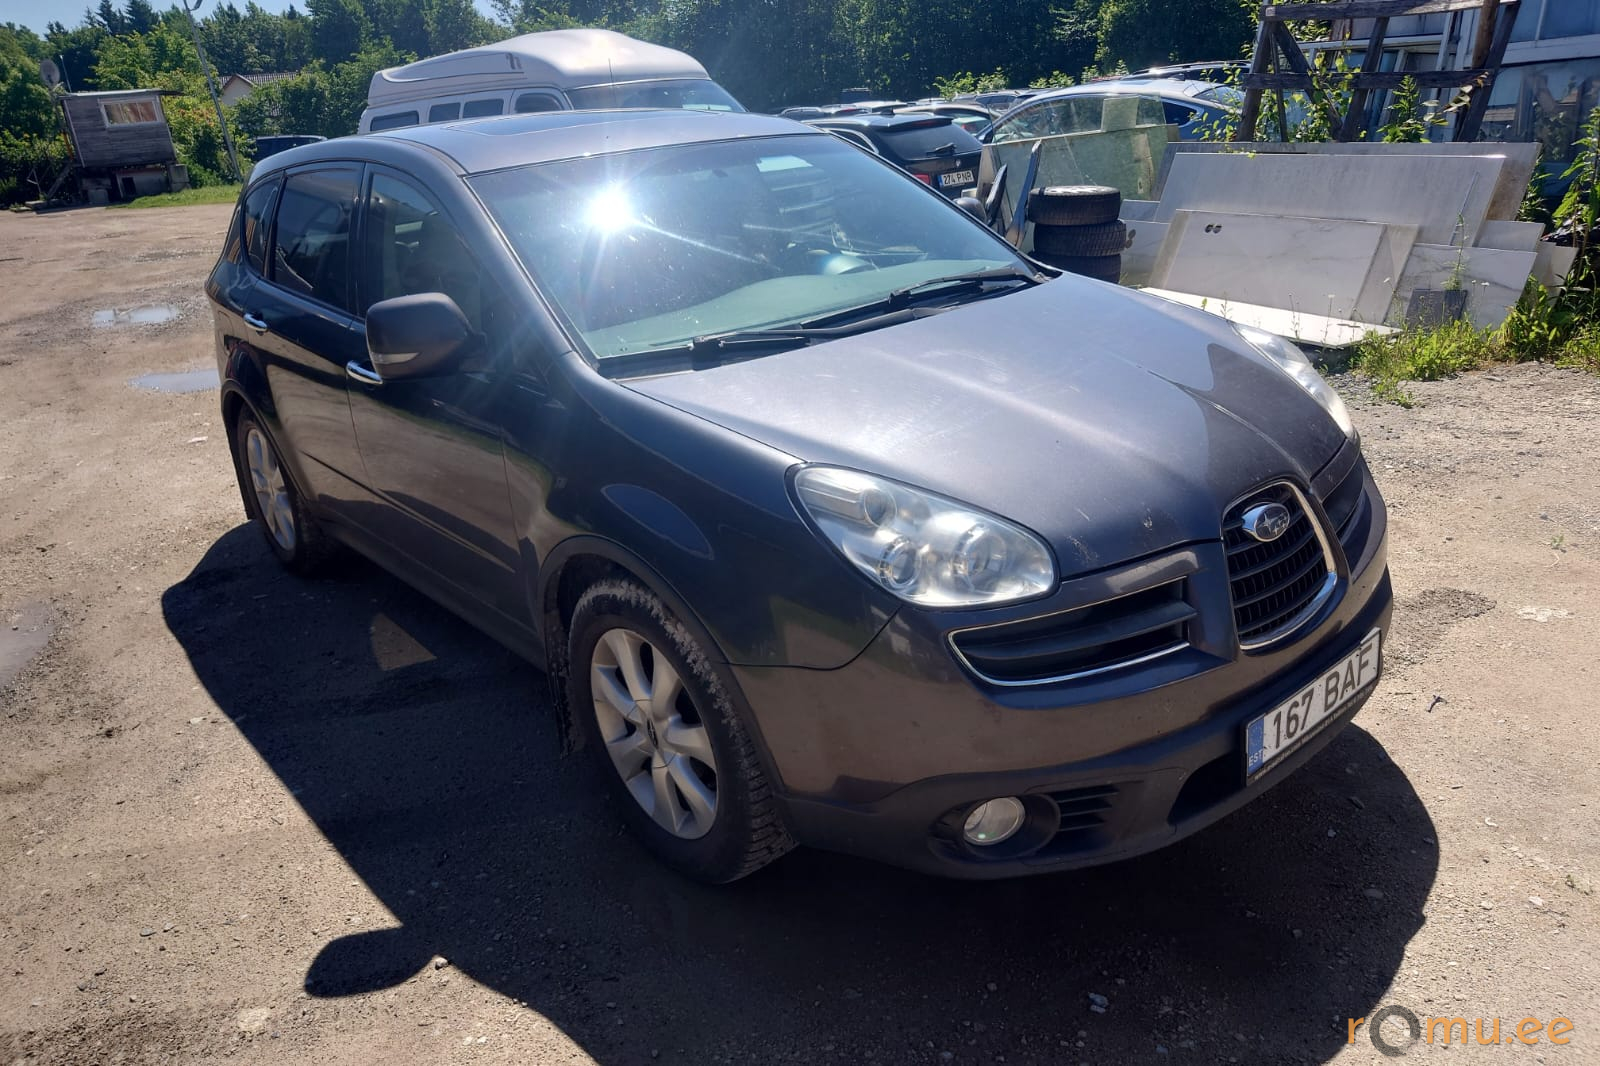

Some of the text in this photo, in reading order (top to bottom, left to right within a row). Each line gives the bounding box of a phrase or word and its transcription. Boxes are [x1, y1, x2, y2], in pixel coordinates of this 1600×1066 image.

[943, 173, 956, 185] 274
[1273, 643, 1373, 750] 167 BAF
[1248, 749, 1264, 767] EST
